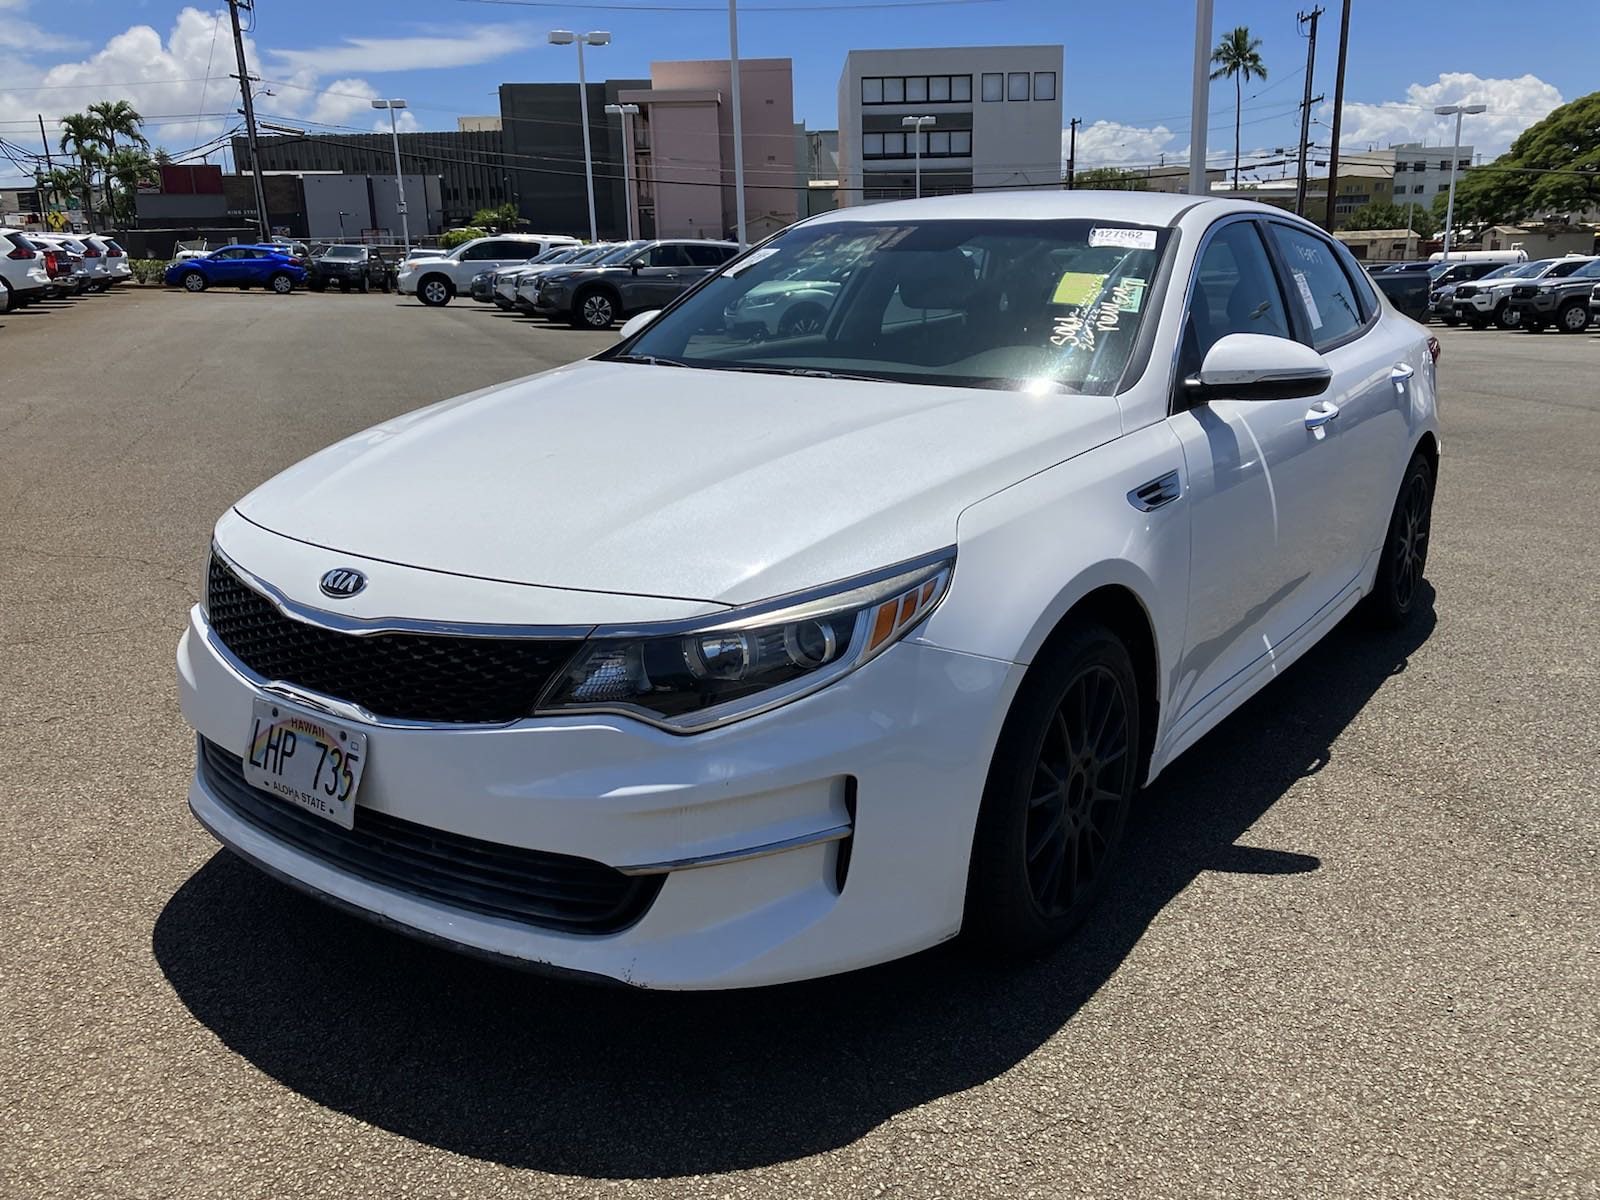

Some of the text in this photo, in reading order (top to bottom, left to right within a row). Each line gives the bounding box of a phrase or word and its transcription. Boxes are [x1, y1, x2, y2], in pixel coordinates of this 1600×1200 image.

[322, 570, 358, 592] KIA
[291, 717, 325, 739] HAWAII
[249, 719, 359, 802] LHP 735
[273, 781, 326, 812] ALOHA STATE
